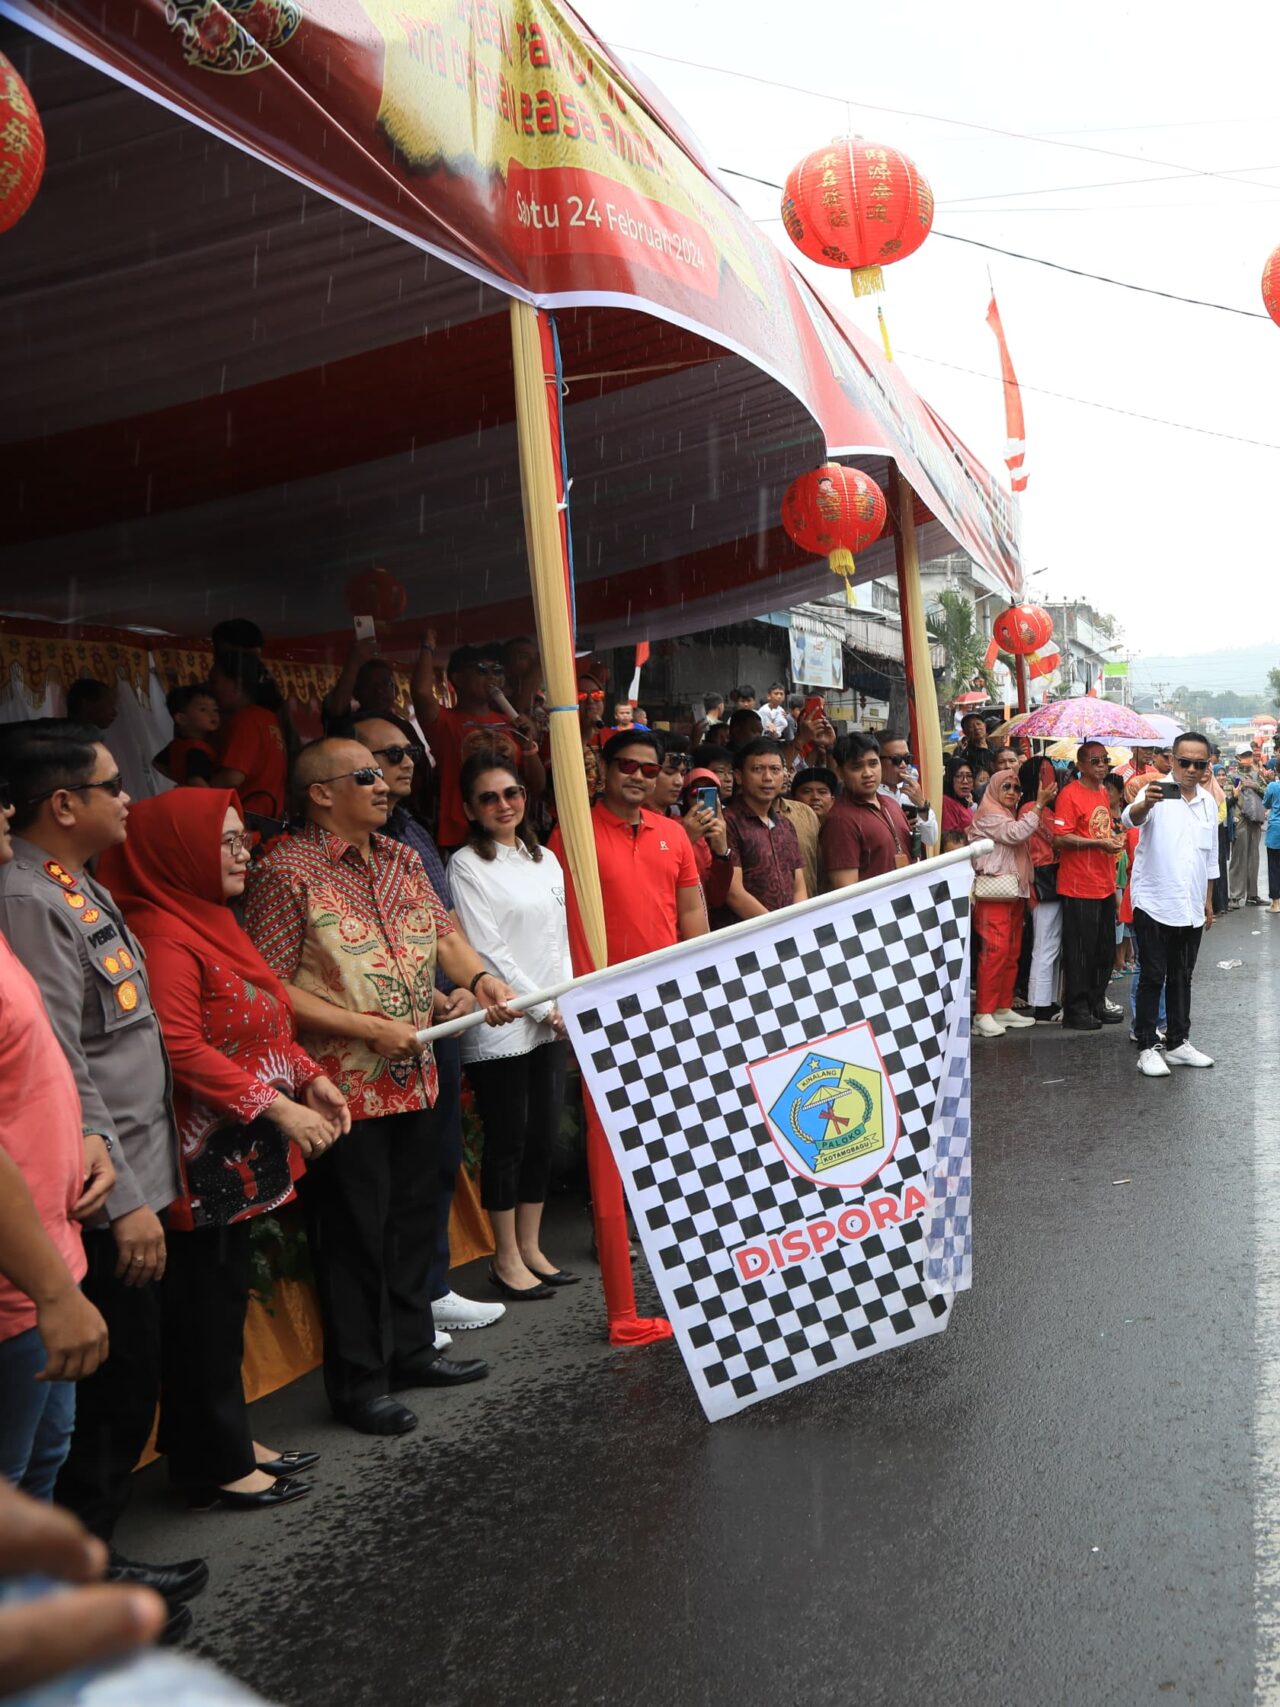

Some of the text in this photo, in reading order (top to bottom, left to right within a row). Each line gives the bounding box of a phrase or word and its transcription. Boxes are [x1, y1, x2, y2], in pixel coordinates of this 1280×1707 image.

[567, 196, 602, 228] 24
[801, 1069, 837, 1088] KINALANG
[821, 1128, 862, 1149] PALOKO
[823, 1141, 870, 1163] KOTAMOBAGU
[735, 1185, 927, 1281] DISPORA
